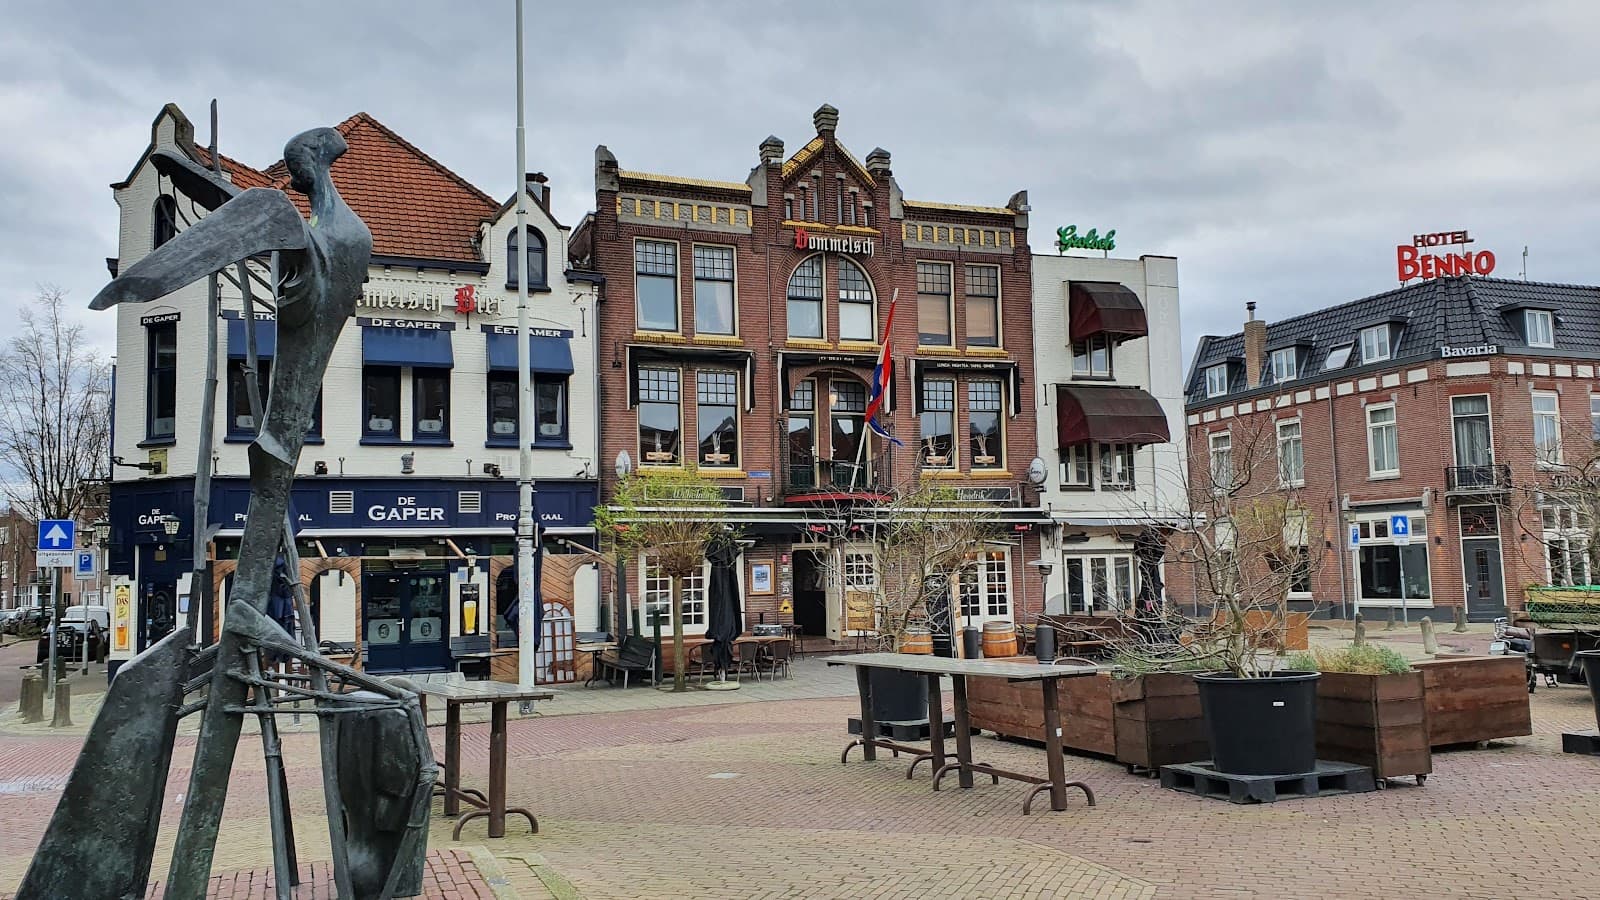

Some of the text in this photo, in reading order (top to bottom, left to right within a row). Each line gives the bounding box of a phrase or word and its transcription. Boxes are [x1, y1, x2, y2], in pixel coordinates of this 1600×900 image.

[795, 226, 875, 258] Dommelsch
[1057, 225, 1116, 252] Grolsch
[1413, 230, 1474, 247] HOTEL
[1397, 245, 1496, 282] BENNO
[455, 284, 505, 317] Bier
[154, 314, 179, 323] GAPER
[371, 318, 441, 330] DE GAPER
[494, 325, 561, 337] EETAMER
[1441, 342, 1498, 358] Bavaria
[397, 496, 416, 506] DE
[139, 515, 168, 525] GAPE
[368, 505, 445, 521] GAPER
[81, 555, 90, 565] P
[116, 597, 129, 606] DAS
